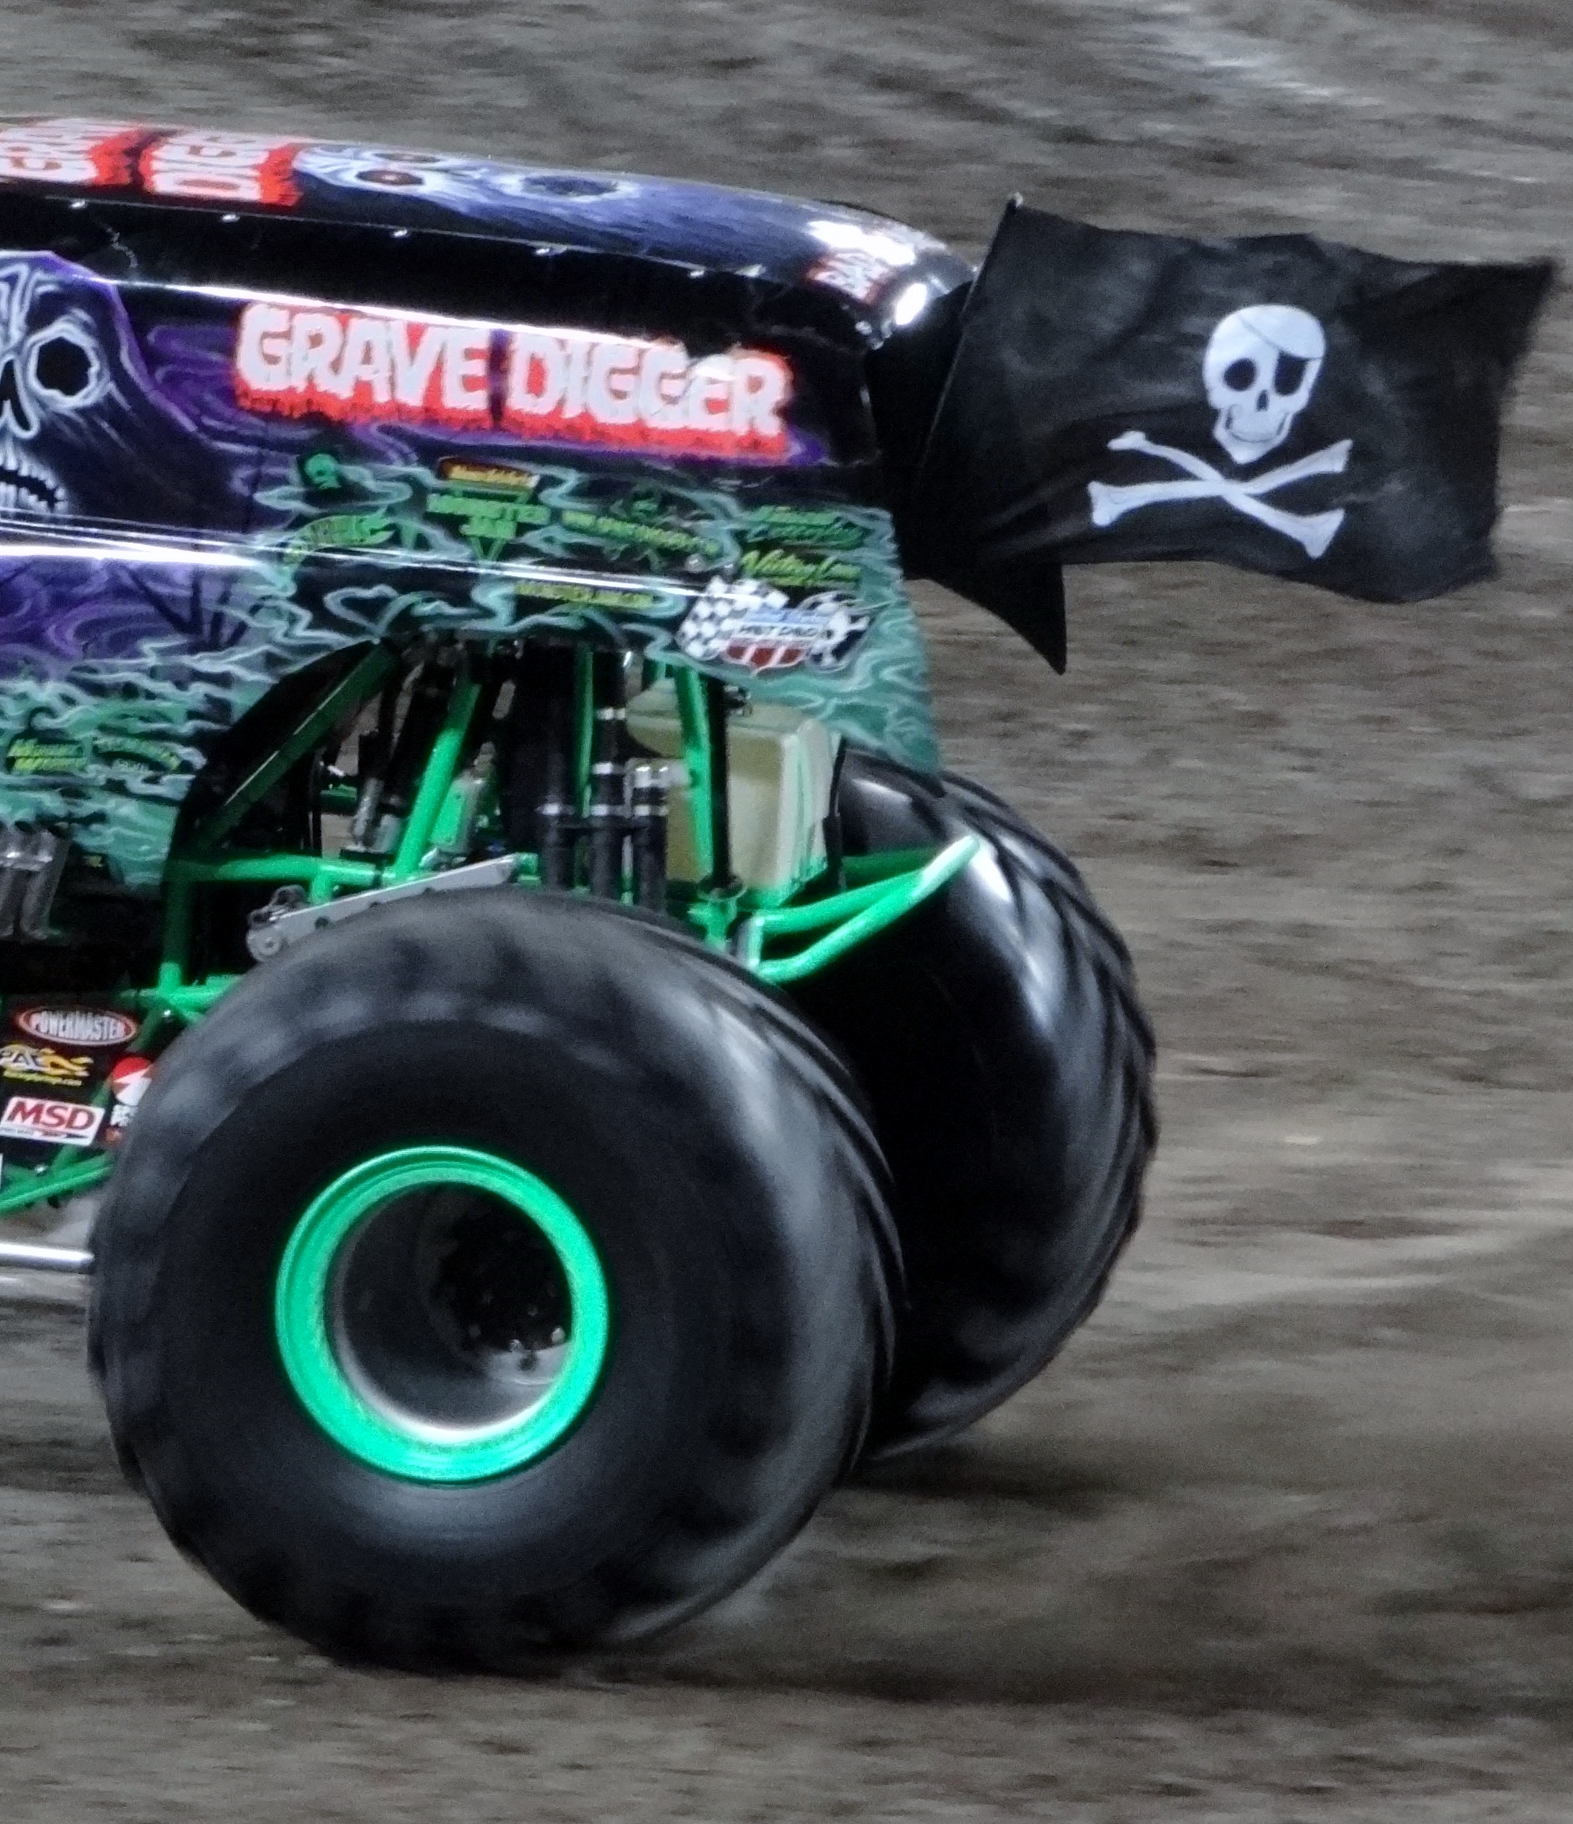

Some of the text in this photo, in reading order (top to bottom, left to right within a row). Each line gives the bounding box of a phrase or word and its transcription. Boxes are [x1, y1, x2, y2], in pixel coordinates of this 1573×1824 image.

[236, 303, 793, 438] GRAVE DIGGER
[31, 1009, 127, 1041] POWERMASTER
[7, 1099, 96, 1131] MSD
